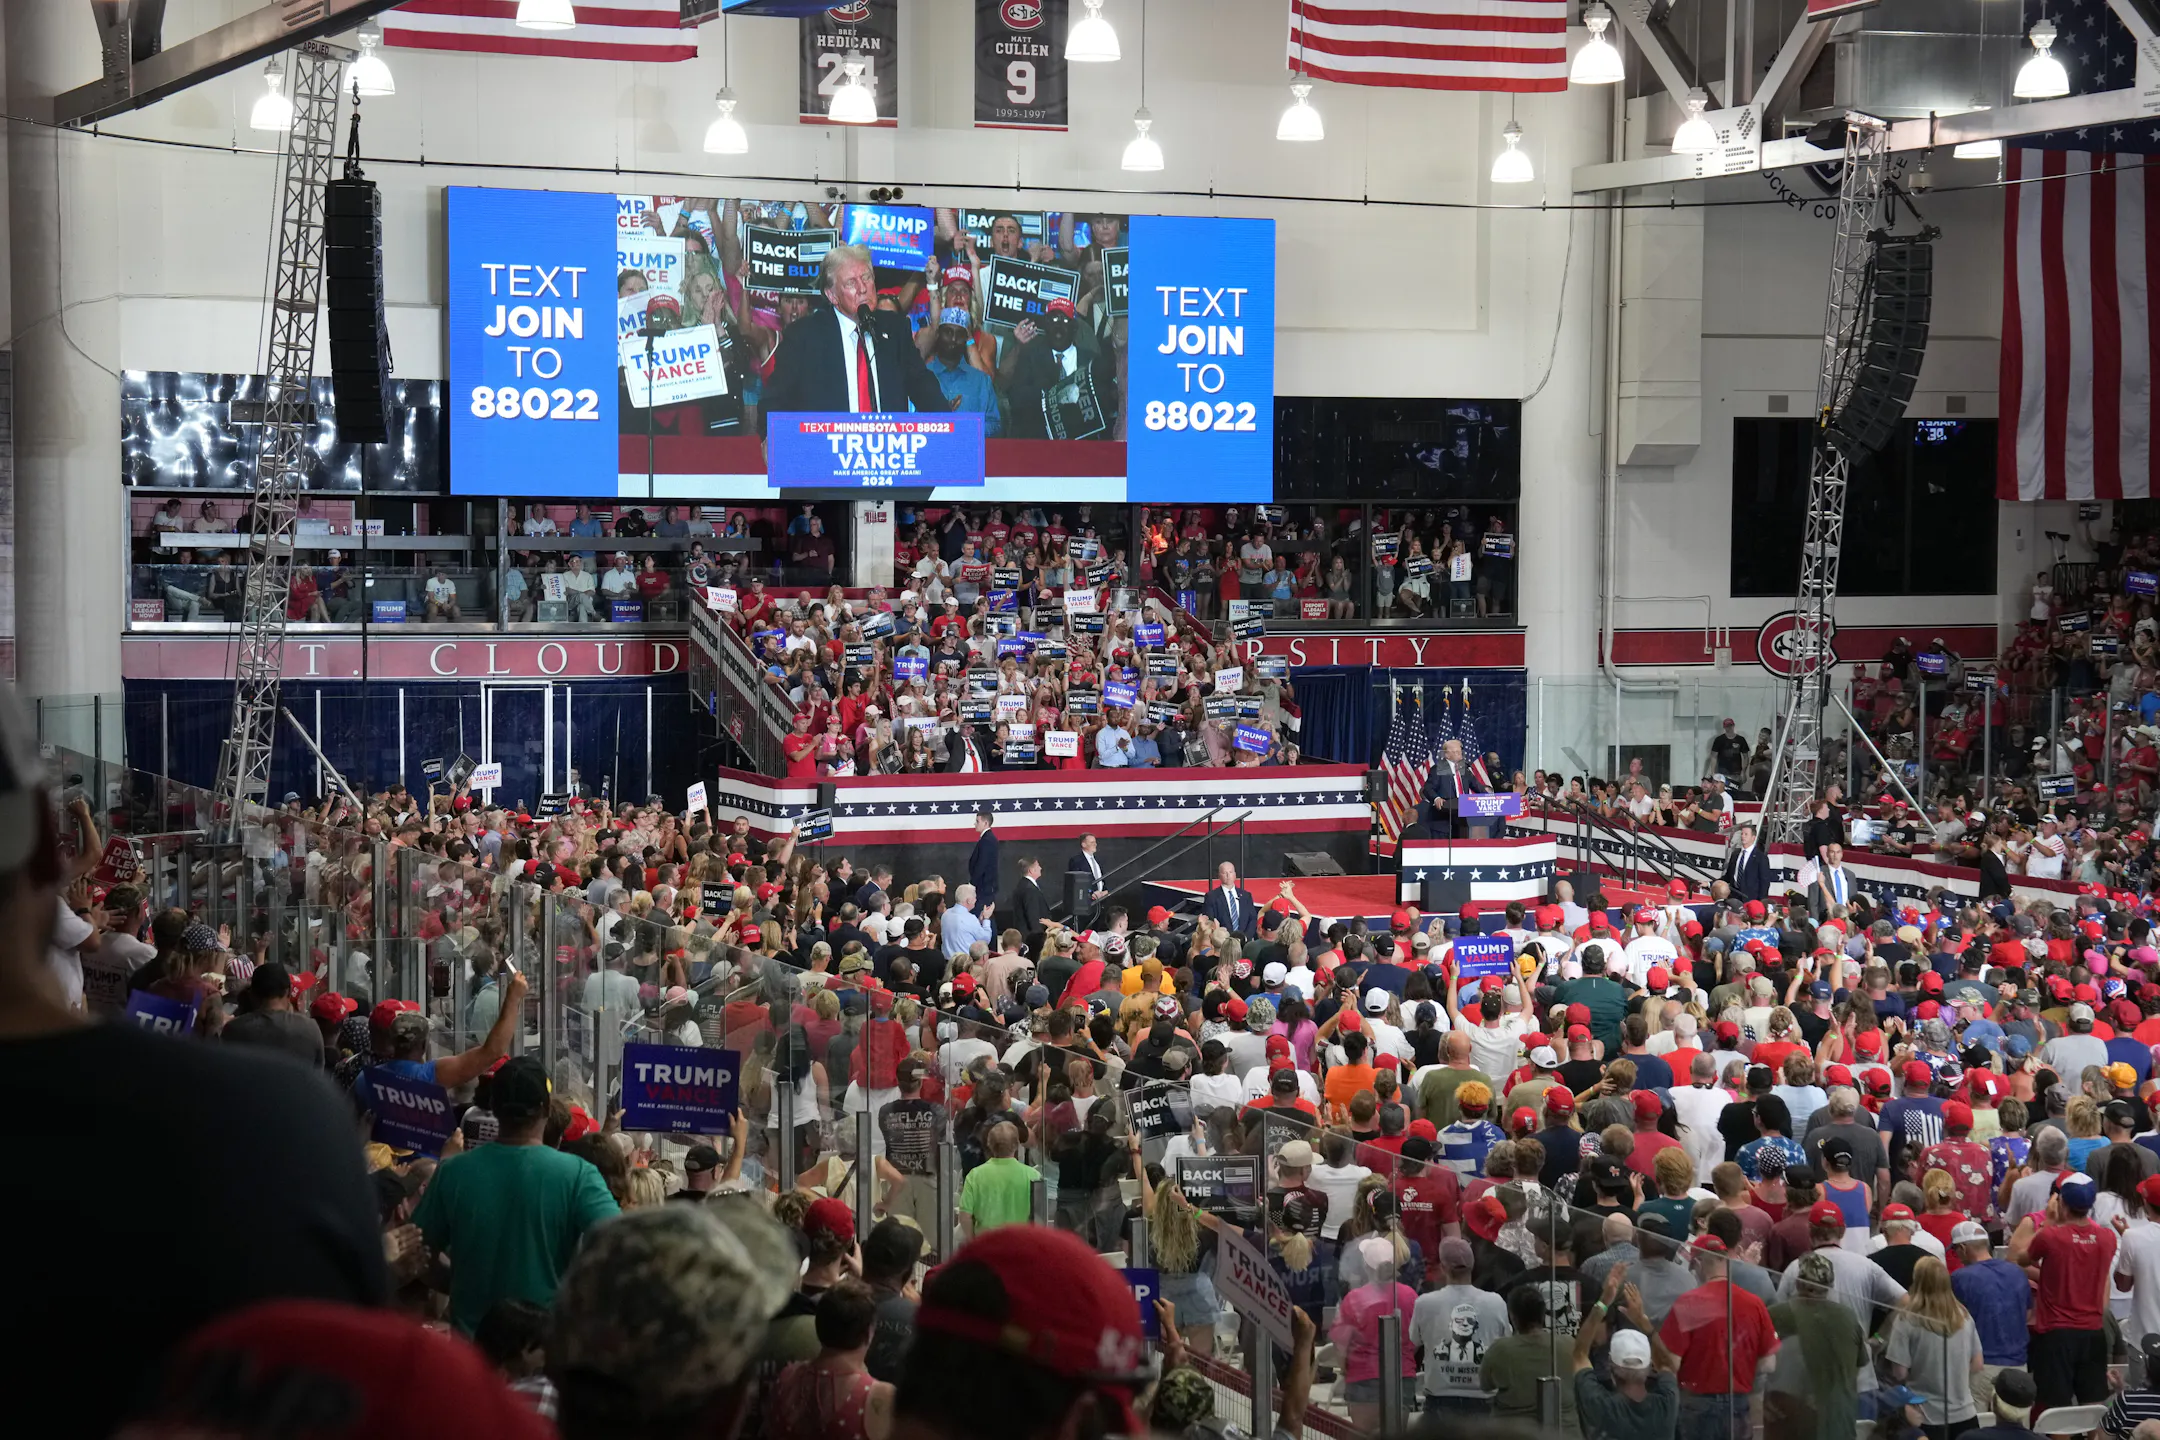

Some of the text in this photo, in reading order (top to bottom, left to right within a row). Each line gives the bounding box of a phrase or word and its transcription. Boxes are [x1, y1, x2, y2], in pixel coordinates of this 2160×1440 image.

[817, 34, 881, 50] HEDICAN
[995, 43, 1049, 57] CULLEN
[1007, 61, 1035, 104] 9
[995, 108, 1046, 119] 1995-1997
[851, 210, 928, 235] TRUMP
[860, 228, 920, 248] VANCE
[752, 241, 797, 259] BACK
[752, 260, 784, 276] THE
[481, 263, 587, 298] TEXT
[996, 272, 1037, 294] BACK
[993, 293, 1023, 312] THE
[1156, 286, 1248, 317] TEXT
[484, 305, 583, 339] JOIN
[1158, 325, 1244, 356] JOIN
[631, 343, 711, 369] TRUMP
[507, 346, 562, 379] TO
[644, 360, 707, 381] VANCE
[1177, 363, 1225, 394] TO
[471, 386, 599, 420] 88022
[1145, 401, 1256, 431] 88022
[804, 423, 951, 433] TEXT MINNESOTA TO 88022
[827, 434, 928, 453] TRUMP
[839, 454, 916, 469] VANCE
[862, 477, 893, 486] 2024
[354, 524, 382, 532] TRUMP
[995, 571, 1009, 579] BACK
[1089, 569, 1104, 578] BACK
[2129, 576, 2157, 586] TRUMP
[711, 591, 736, 600] TRUMP
[713, 596, 733, 605] VANCE
[376, 605, 404, 613] TRUMP
[614, 604, 641, 613] TRUMP
[1137, 629, 1162, 637] TRUMP
[430, 642, 681, 675] CLOUD
[1918, 656, 1944, 665] TRUMP
[896, 661, 925, 669] TRUMP
[1218, 674, 1241, 682] TRUMP
[962, 704, 978, 712] BACK
[1149, 706, 1166, 714] BACK
[1148, 712, 1160, 720] THE
[1239, 729, 1268, 742] TRUMP
[471, 769, 499, 777] TRUMP
[2041, 779, 2060, 787] BACK
[2056, 785, 2074, 793] BLUE
[797, 820, 817, 829] BACK
[813, 826, 830, 834] BLUE
[705, 890, 722, 898] BACK
[1459, 945, 1510, 955] TRUMP
[1465, 953, 1505, 963] VANCE
[1641, 954, 1670, 962] TRUMP
[635, 1063, 732, 1088] TRUMP
[373, 1083, 446, 1115] TRUMP
[646, 1083, 720, 1104] VANCE
[657, 1103, 683, 1111] AMERICA
[1133, 1096, 1169, 1114] BACK
[900, 1111, 933, 1123] FLAG
[1136, 1114, 1162, 1128] THE
[1183, 1170, 1223, 1181] BACK
[1183, 1187, 1211, 1197] THE
[1233, 1263, 1289, 1318] VANCE
[1441, 1366, 1455, 1374] YOU
